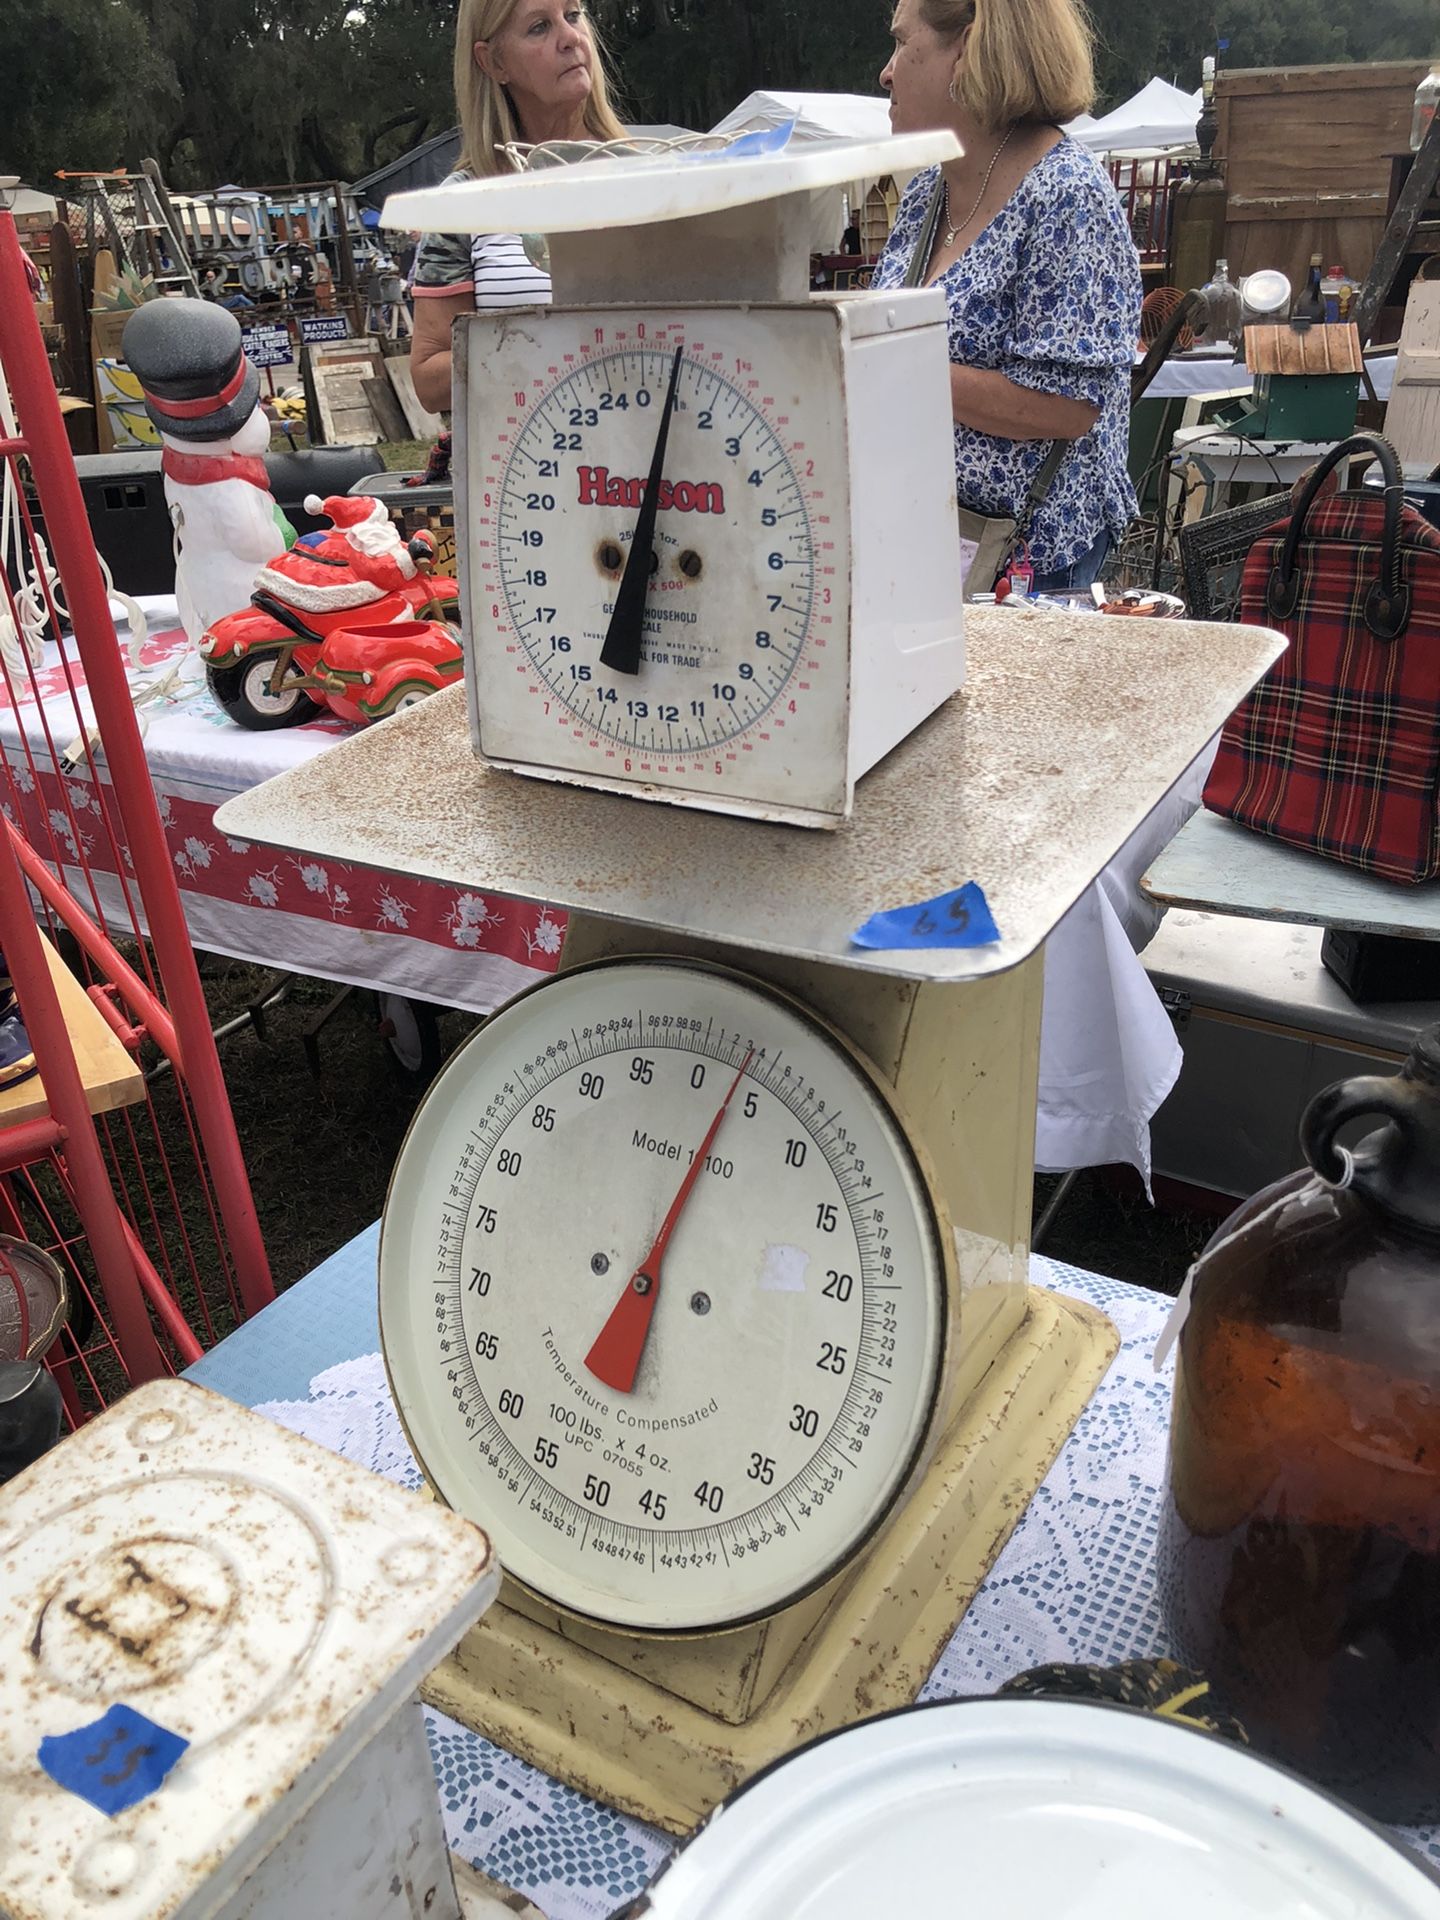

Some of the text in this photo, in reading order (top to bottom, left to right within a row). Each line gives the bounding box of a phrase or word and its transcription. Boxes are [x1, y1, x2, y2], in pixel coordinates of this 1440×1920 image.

[304, 321, 344, 331] WATKINS
[638, 323, 645, 339] 0
[304, 330, 346, 339] PRODUCTS
[594, 328, 603, 344] 11
[514, 392, 525, 407] 10
[599, 393, 629, 410] 24
[636, 389, 651, 407] 0
[569, 409, 599, 426] 23
[698, 412, 712, 429] 2
[553, 433, 583, 451] 22
[725, 438, 741, 456] 3
[539, 460, 558, 477] 21
[806, 460, 814, 477] 2
[748, 470, 763, 487] 4
[577, 466, 725, 514] Hanson
[484, 493, 491, 507] 9
[527, 493, 555, 511] 20
[761, 509, 777, 526] 5
[522, 530, 543, 547] 19
[768, 552, 783, 570] 6
[526, 570, 547, 586] 18
[767, 595, 782, 612] 7
[823, 588, 831, 604] 3
[493, 605, 499, 618] 8
[536, 607, 556, 623] 17
[645, 608, 697, 624] HOUSEHOLD
[550, 636, 571, 652] 16
[755, 631, 770, 648] 8
[652, 652, 668, 664] FOR
[672, 655, 700, 668] TRADE
[570, 664, 592, 681] 15
[738, 663, 753, 680] 9
[597, 687, 618, 703] 14
[712, 683, 736, 701] 10
[544, 702, 550, 715] 7
[627, 701, 648, 718] 13
[658, 705, 680, 722] 12
[690, 701, 704, 717] 11
[788, 700, 796, 714] 4
[624, 759, 632, 772] 6
[716, 761, 722, 775] 5
[608, 1020, 619, 1032] 93
[622, 1017, 632, 1029] 94
[649, 1015, 660, 1027] 96
[662, 1016, 673, 1027] 97
[676, 1017, 688, 1029] 98
[583, 1028, 592, 1039] 91
[596, 1024, 606, 1036] 92
[721, 1029, 724, 1038] 1
[733, 1034, 740, 1045] 2
[746, 1040, 753, 1050] 3
[536, 1055, 546, 1066] 87
[759, 1048, 766, 1059] 4
[629, 1057, 654, 1085] 95
[691, 1064, 705, 1089] 0
[785, 1066, 791, 1077] 6
[579, 1072, 604, 1099] 90
[797, 1076, 803, 1087] 7
[808, 1088, 815, 1099] 8
[744, 1092, 758, 1118] 5
[818, 1101, 825, 1112] 9
[479, 1118, 488, 1128] 81
[532, 1105, 556, 1132] 85
[838, 1128, 846, 1140] 11
[465, 1144, 474, 1155] 79
[632, 1129, 681, 1160] Model
[846, 1142, 856, 1155] 12
[785, 1139, 806, 1168] 10
[459, 1156, 468, 1168] 78
[497, 1149, 521, 1176] 80
[854, 1159, 864, 1172] 13
[454, 1171, 464, 1182] 77
[862, 1176, 871, 1188] 14
[449, 1184, 459, 1197] 76
[442, 1214, 451, 1226] 74
[476, 1205, 497, 1233] 75
[816, 1203, 838, 1232] 15
[873, 1209, 884, 1223] 16
[440, 1229, 449, 1242] 73
[877, 1227, 888, 1240] 17
[438, 1245, 447, 1257] 72
[880, 1246, 891, 1259] 18
[437, 1261, 446, 1273] 71
[883, 1263, 894, 1278] 19
[468, 1268, 491, 1296] 70
[822, 1270, 853, 1302] 20
[883, 1301, 895, 1315] 21
[438, 1322, 447, 1334] 67
[883, 1318, 897, 1333] 22
[476, 1331, 499, 1360] 65
[881, 1336, 895, 1351] 23
[816, 1342, 847, 1374] 25
[878, 1354, 892, 1368] 24
[542, 1327, 719, 1432] Temperature Compensated
[869, 1388, 883, 1403] 26
[499, 1389, 524, 1418] 60
[863, 1405, 877, 1419] 27
[466, 1416, 475, 1429] 61
[789, 1404, 819, 1437] 30
[856, 1422, 870, 1436] 28
[550, 1404, 576, 1427] 100
[580, 1417, 604, 1442] lbs.
[635, 1443, 646, 1459] 4
[650, 1454, 671, 1473] oz.
[849, 1438, 862, 1452] 29
[534, 1437, 559, 1468] 55
[565, 1432, 643, 1477] UPC 07055
[498, 1468, 508, 1480] 57
[747, 1452, 776, 1485] 35
[831, 1466, 843, 1481] 31
[584, 1474, 610, 1507] 50
[821, 1478, 834, 1494] 32
[638, 1489, 667, 1520] 45
[694, 1481, 723, 1513] 40
[811, 1491, 824, 1505] 33
[530, 1499, 541, 1512] 54
[799, 1503, 811, 1517] 34
[542, 1509, 553, 1522] 53
[553, 1519, 564, 1531] 52
[566, 1525, 576, 1538] 51
[592, 1538, 604, 1552] 49
[760, 1531, 772, 1544] 37
[618, 1548, 631, 1560] 47
[706, 1552, 716, 1565] 41
[732, 1544, 745, 1558] 39
[675, 1555, 687, 1568] 43
[690, 1554, 702, 1568] 42
